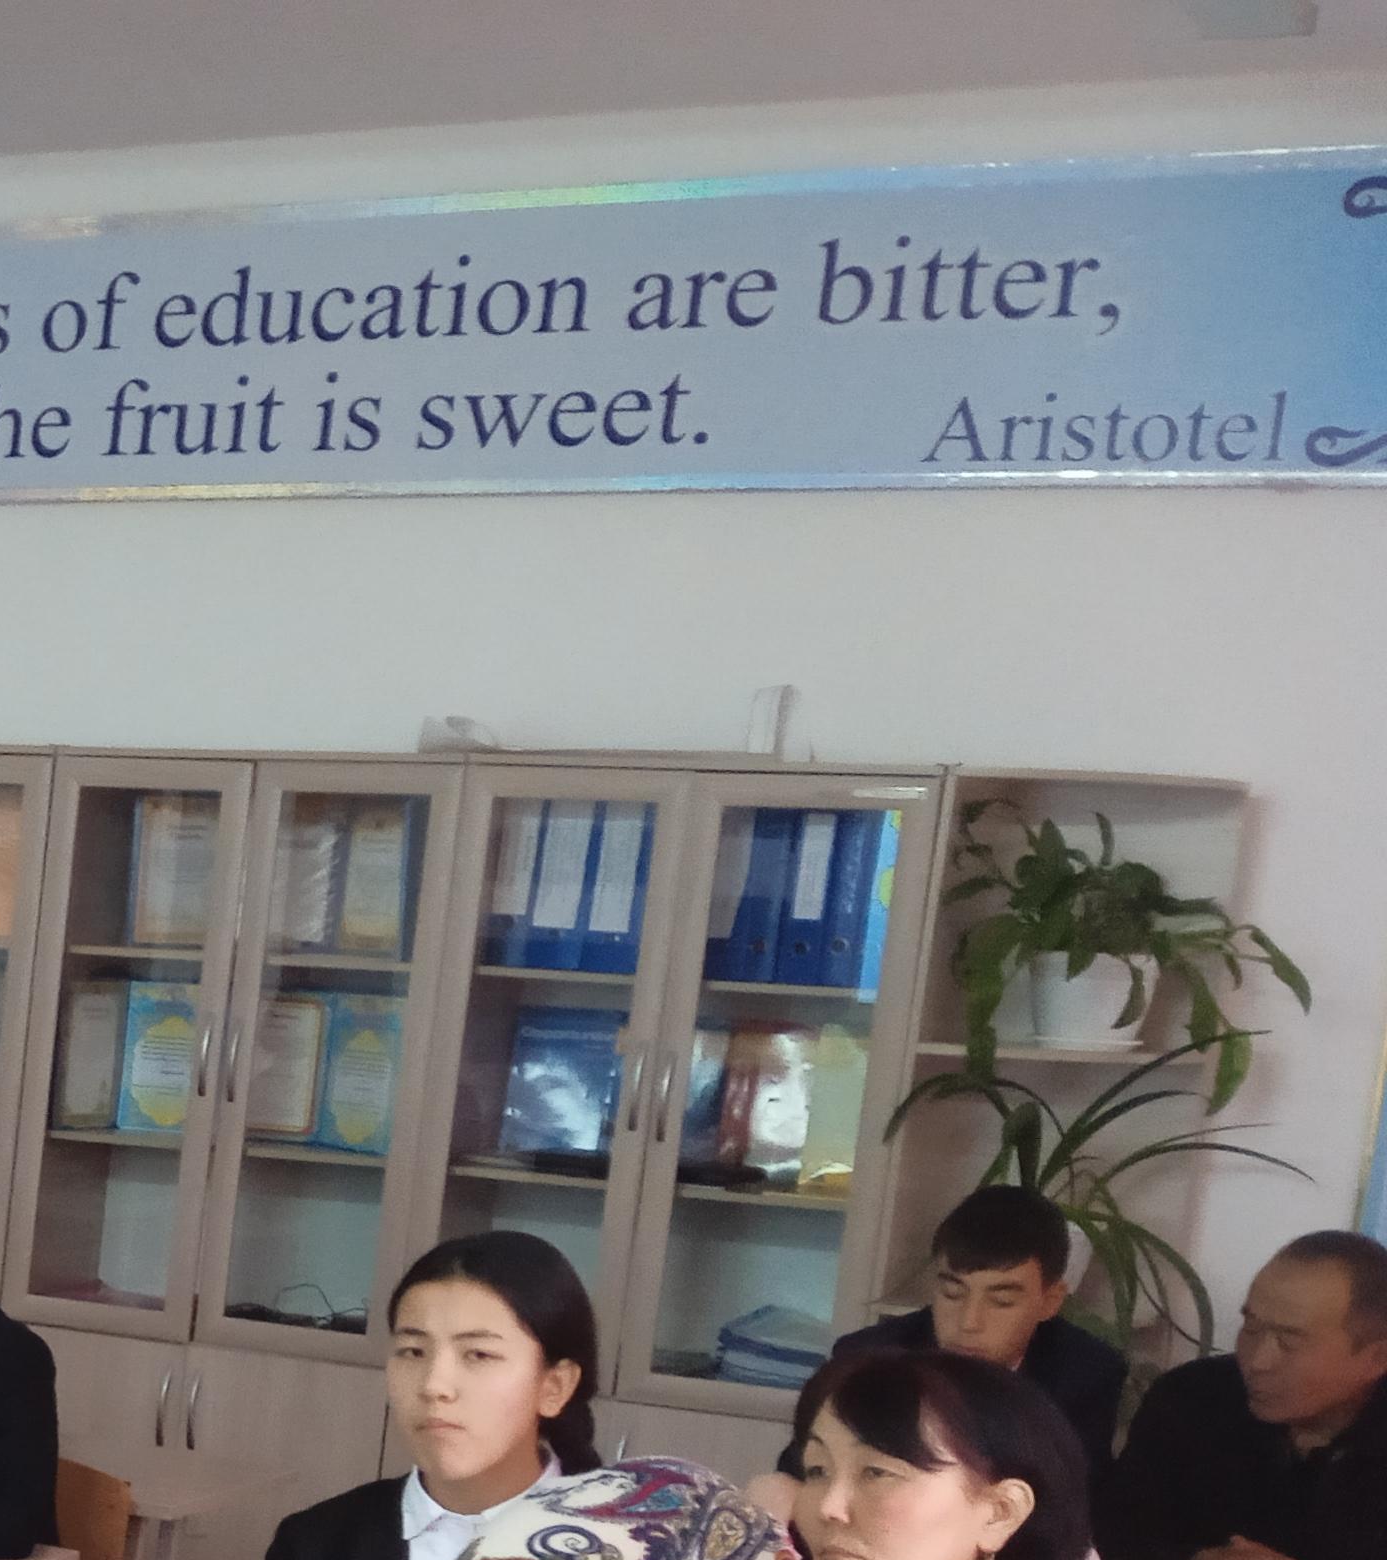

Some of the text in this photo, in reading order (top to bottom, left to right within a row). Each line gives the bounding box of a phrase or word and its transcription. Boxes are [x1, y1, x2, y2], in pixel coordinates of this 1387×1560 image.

[41, 271, 142, 353] of
[153, 255, 592, 348] education
[626, 267, 778, 332] are
[817, 235, 1122, 336] bitter,
[100, 374, 285, 458] fruit
[313, 373, 382, 453] is
[416, 373, 711, 450] sweet.
[919, 392, 1291, 464] Aristotel
